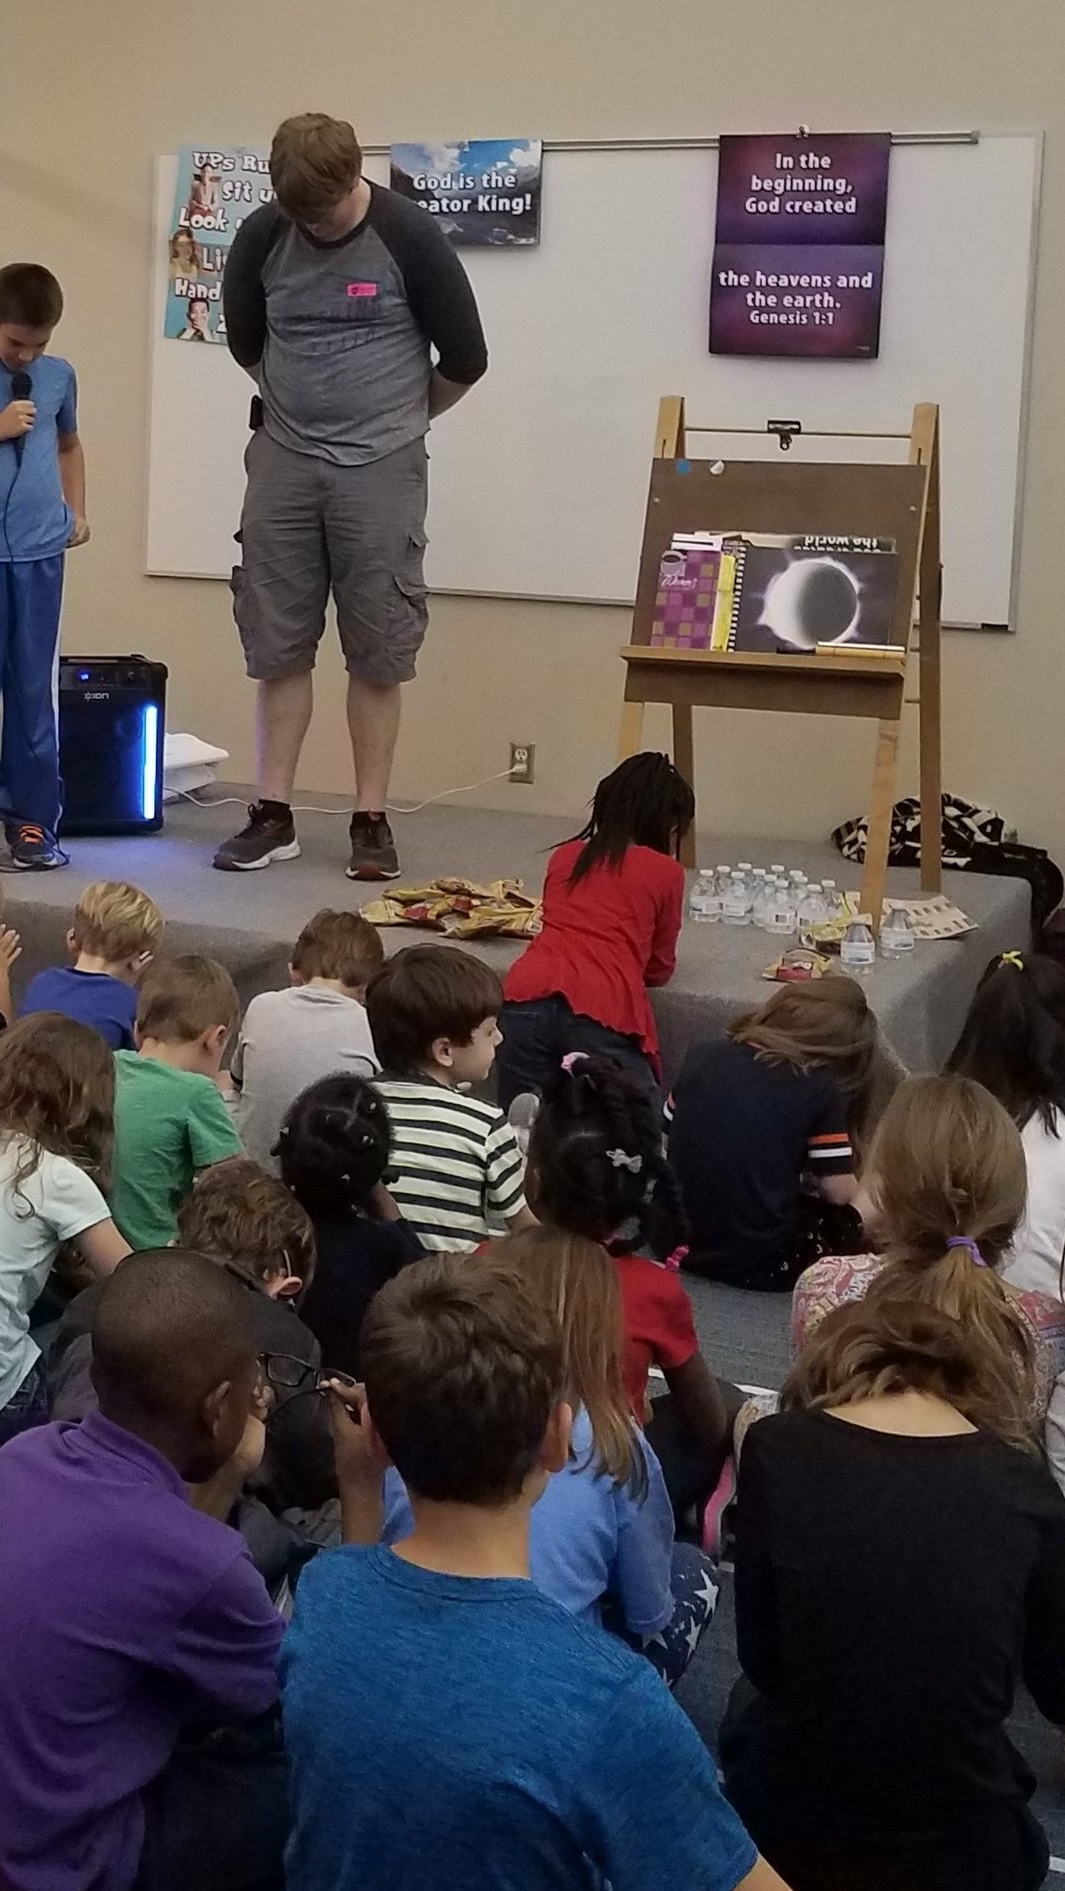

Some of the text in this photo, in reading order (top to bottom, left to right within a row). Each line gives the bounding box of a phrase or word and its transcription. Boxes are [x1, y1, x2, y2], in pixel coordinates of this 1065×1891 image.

[193, 152, 271, 174] UPs Ru
[775, 152, 832, 169] In the
[413, 171, 516, 190] God is the
[751, 174, 854, 194] beginning,
[222, 180, 252, 203] Sit
[416, 193, 532, 215] eator King!
[745, 197, 857, 213] God created
[178, 207, 229, 232] Look
[718, 270, 874, 288] the heavens and
[175, 278, 222, 301] Hand
[746, 291, 842, 309] the earth.
[749, 310, 834, 325] Genesis 1:1
